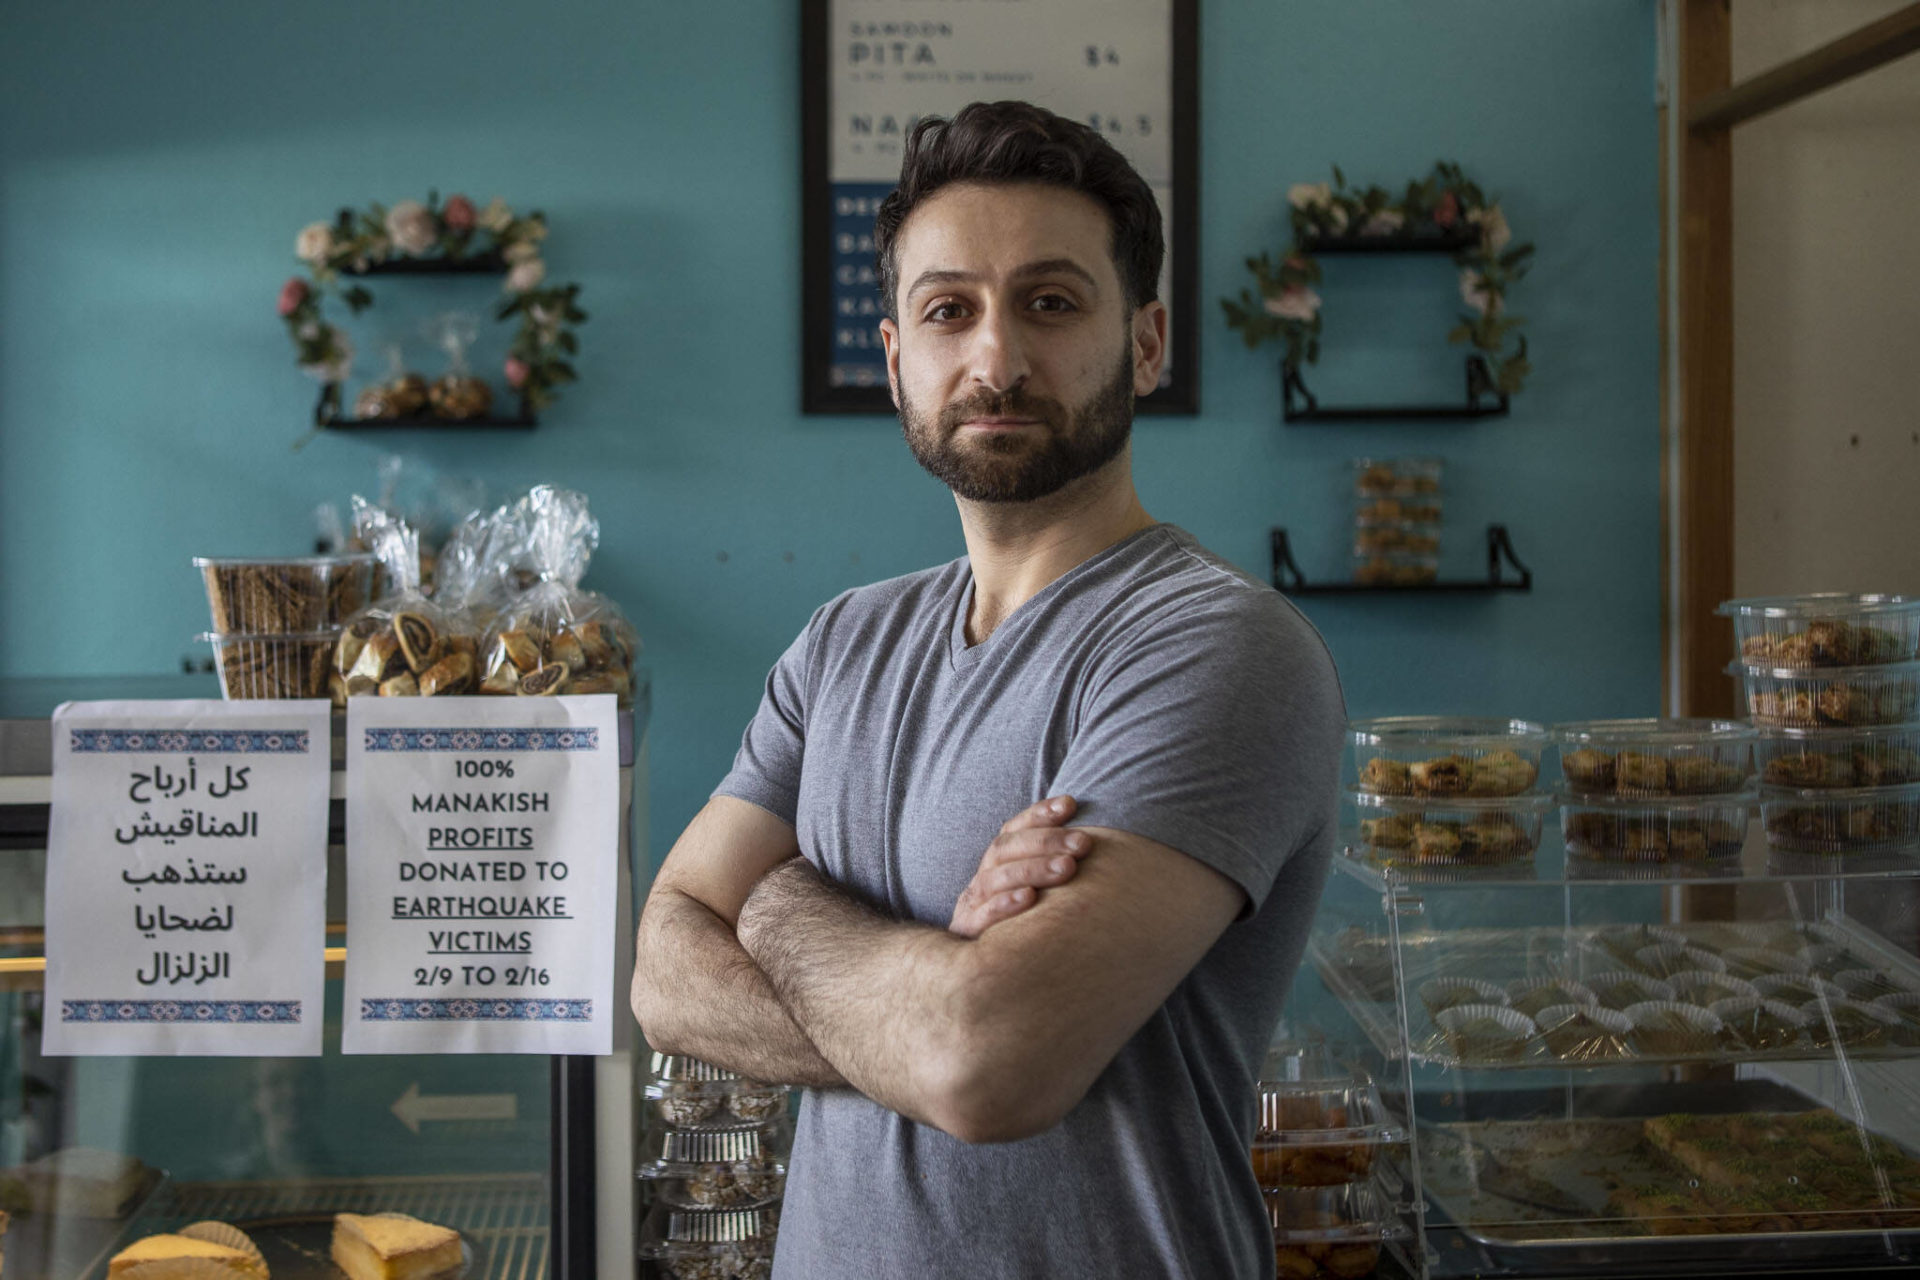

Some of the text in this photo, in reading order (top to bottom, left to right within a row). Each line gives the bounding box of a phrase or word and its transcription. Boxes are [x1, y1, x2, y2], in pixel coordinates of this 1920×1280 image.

[848, 42, 935, 64] PITA
[129, 756, 251, 803] كل أرباح
[454, 760, 515, 779] 100%
[411, 792, 550, 813] MANAKISH
[114, 808, 258, 845] المناقيش
[428, 827, 534, 848] PROFITS
[121, 857, 247, 893] ستذهب
[399, 861, 569, 882] DONATED TO
[392, 896, 567, 918] EARTHQUAKE
[134, 904, 234, 940] لضحايا
[428, 930, 532, 951] VICTIMS
[136, 951, 230, 986] الزلزال
[413, 965, 550, 987] 2/9 TO 2/16
